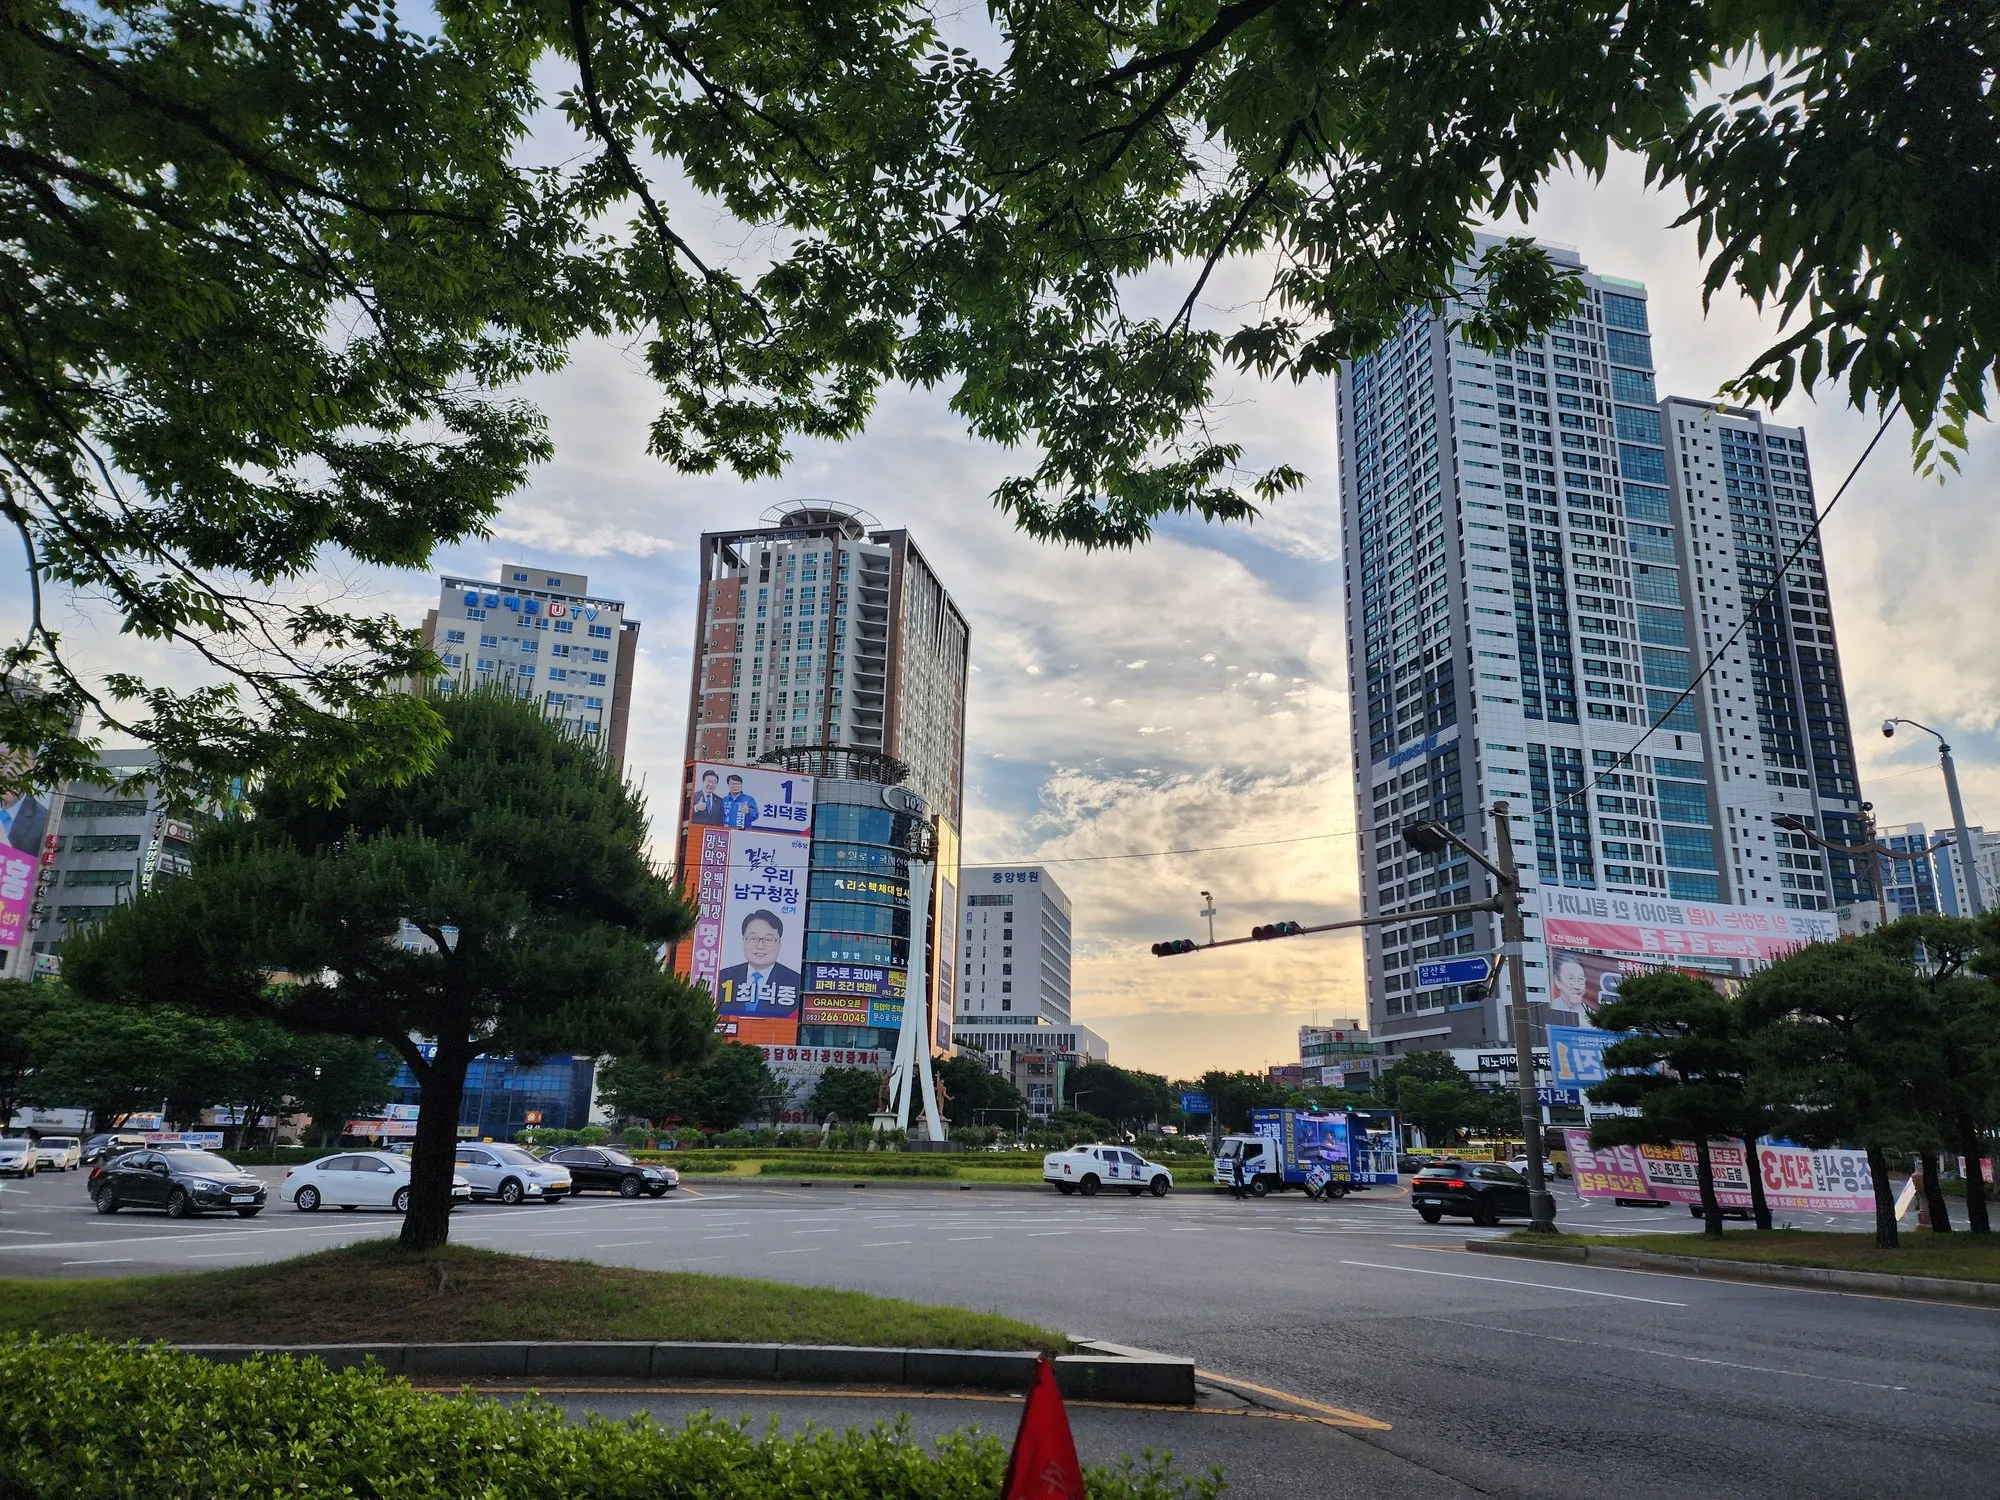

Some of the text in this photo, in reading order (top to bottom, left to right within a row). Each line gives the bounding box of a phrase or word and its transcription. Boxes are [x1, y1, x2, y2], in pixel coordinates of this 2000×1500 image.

[781, 780, 793, 805] 1
[763, 804, 808, 821] 최덕종
[762, 866, 794, 885] 우리
[992, 871, 1039, 884] 중앙병원
[734, 884, 800, 905] 남구청장
[781, 906, 796, 915] 선거
[816, 966, 850, 979] 문수로
[853, 968, 883, 982] 코아루
[1421, 965, 1447, 977] 삼산로
[837, 982, 855, 990] 조건
[1421, 976, 1451, 985] Samsan-ro
[721, 979, 797, 1006] 1 최덕종
[873, 1012, 890, 1022] 문수로
[1537, 1088, 1571, 1104] 치과
[1332, 1173, 1351, 1182] 교육감
